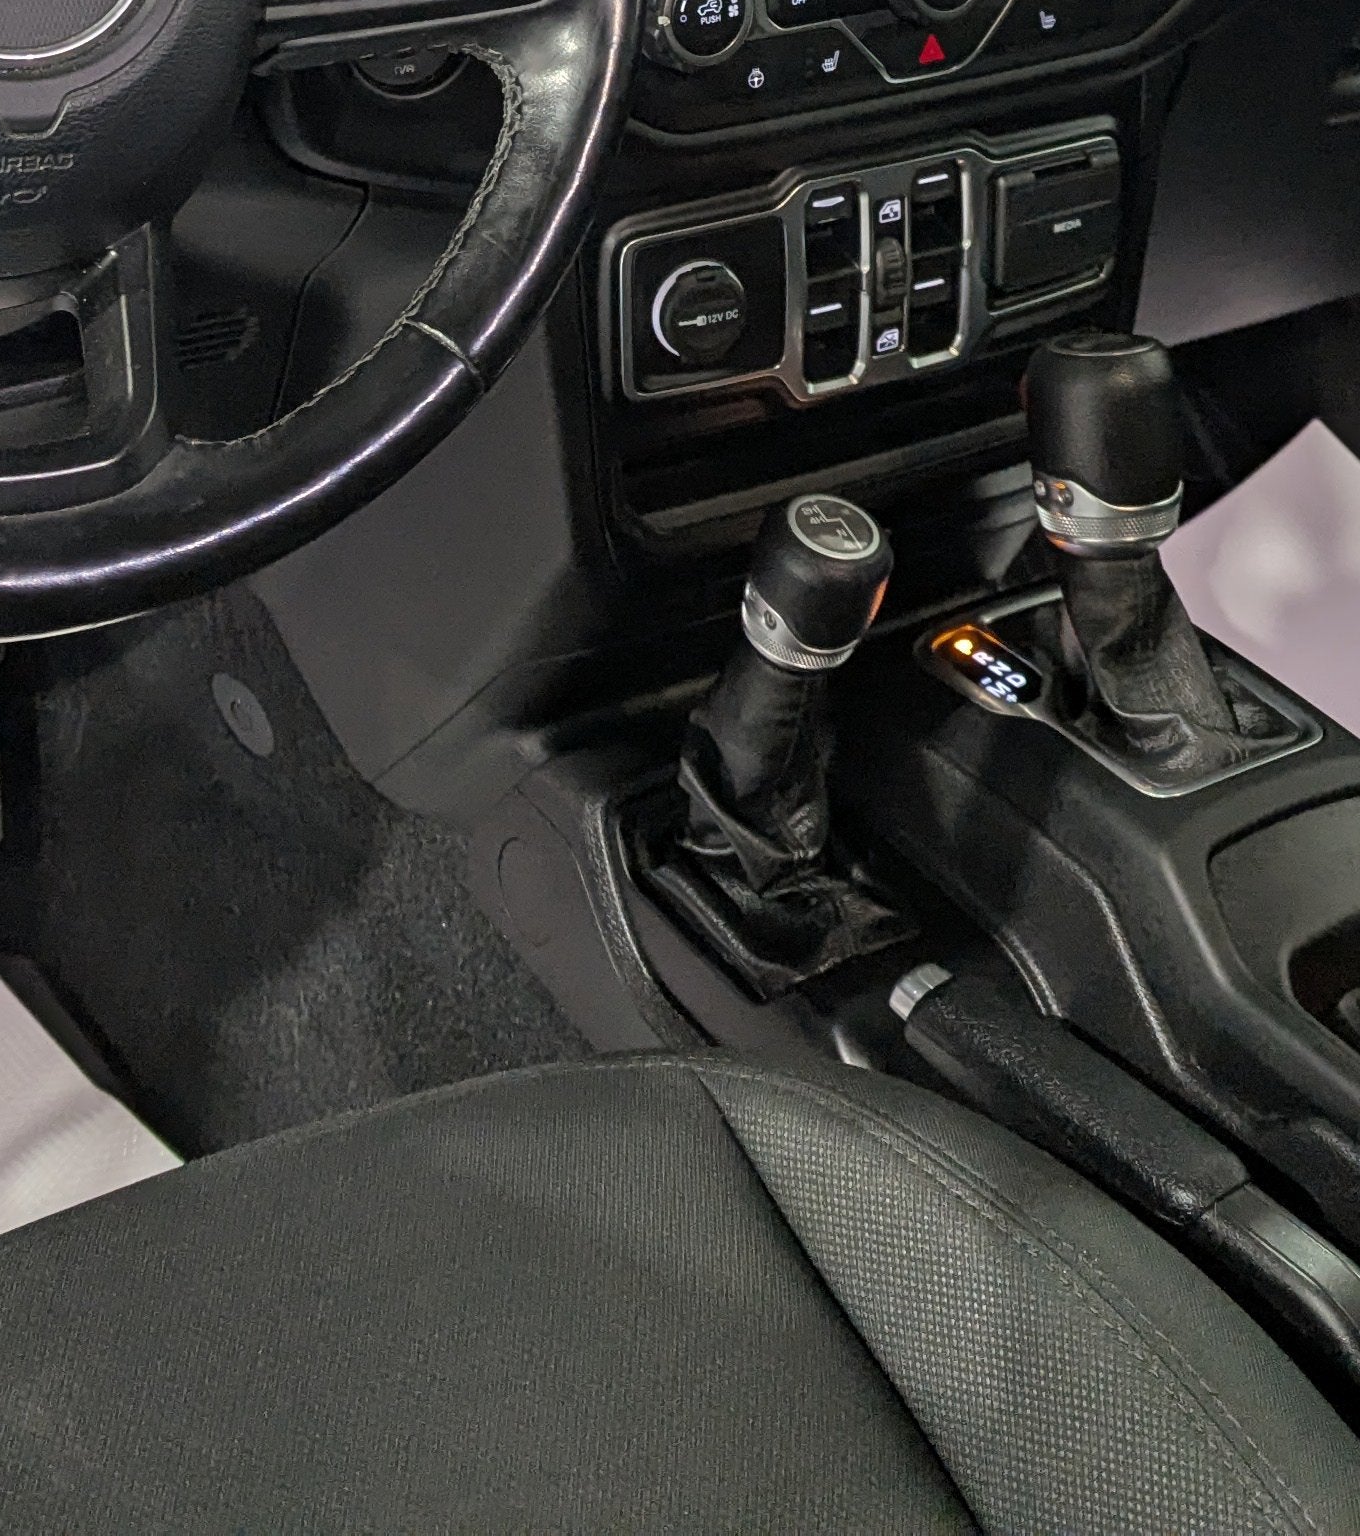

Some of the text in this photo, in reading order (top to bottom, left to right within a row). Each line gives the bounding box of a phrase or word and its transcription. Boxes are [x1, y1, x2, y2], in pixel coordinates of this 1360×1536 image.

[700, 14, 722, 26] PUSH
[708, 308, 739, 324] 12V DC
[972, 651, 994, 665] R
[987, 661, 1012, 676] N
[1005, 674, 1027, 688] D
